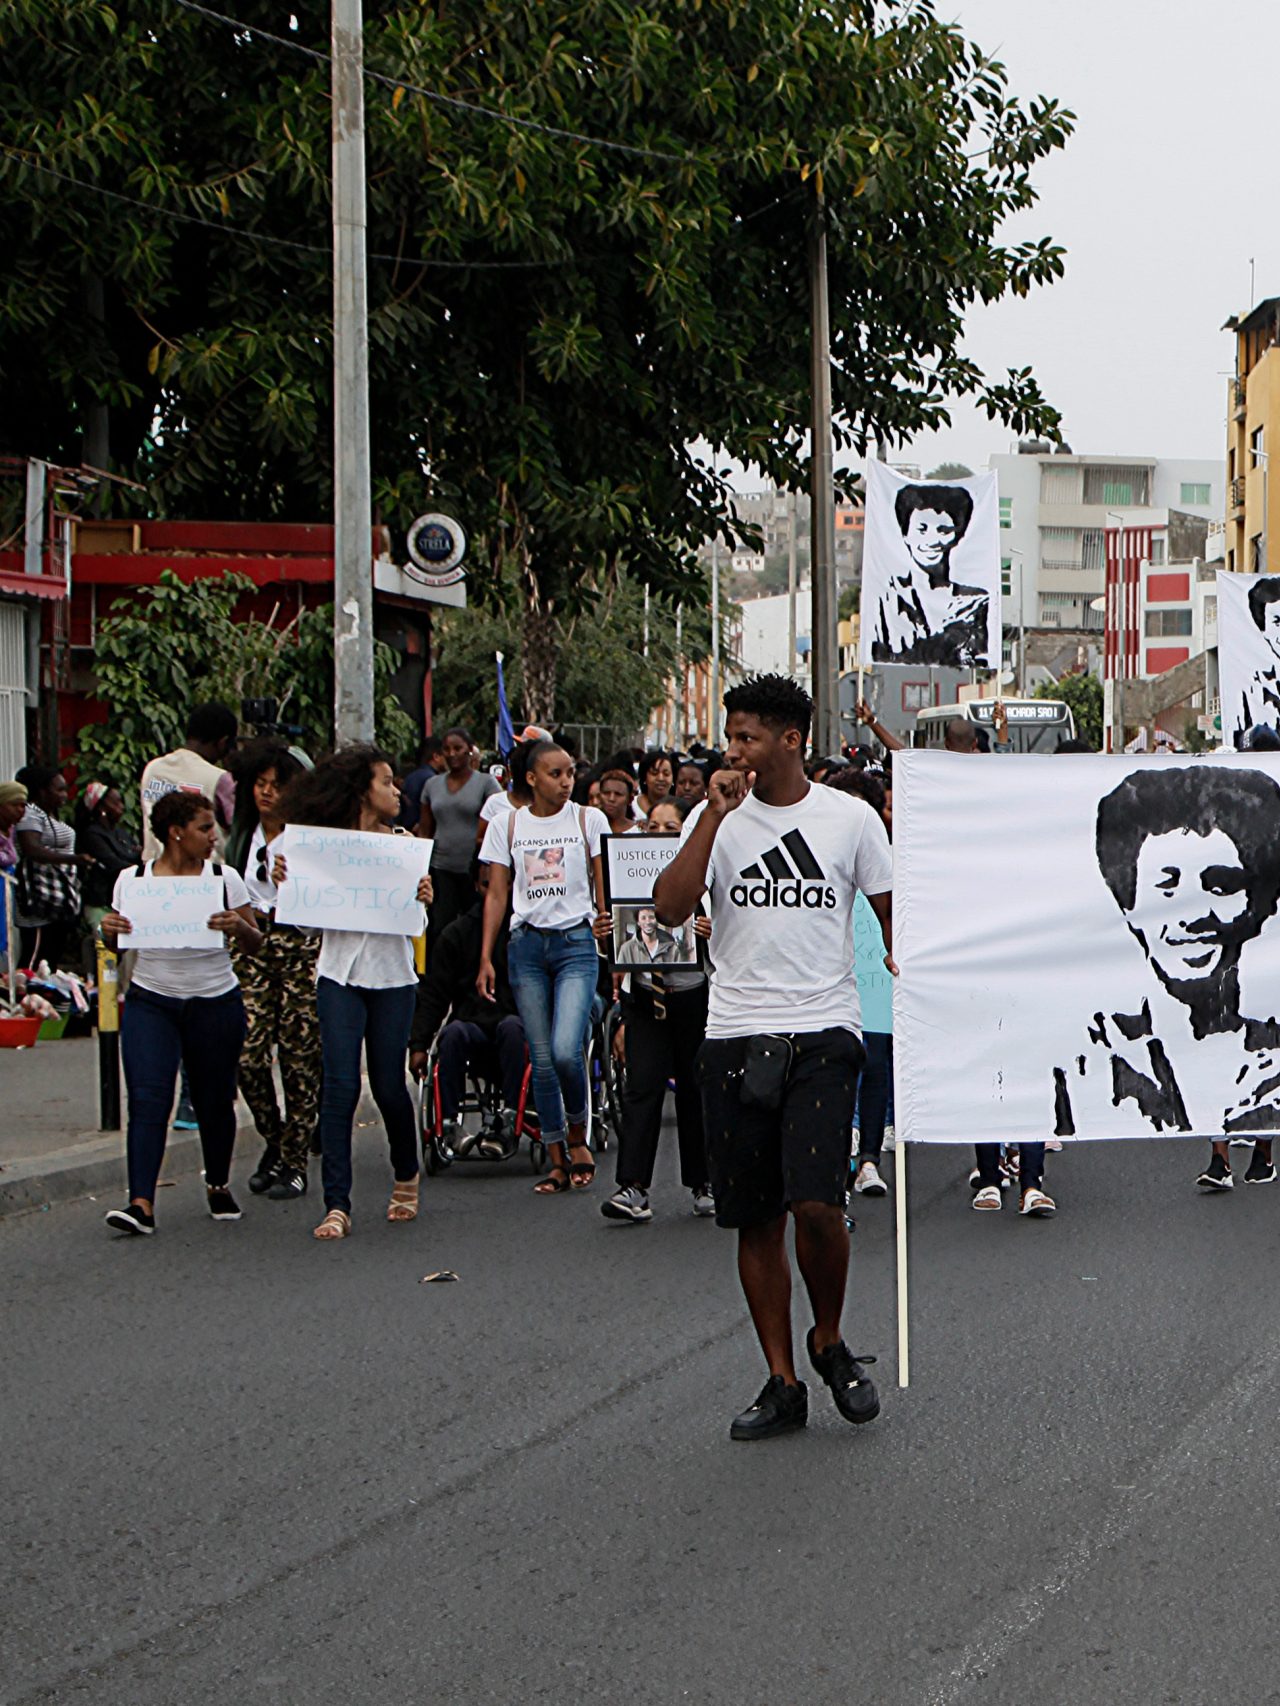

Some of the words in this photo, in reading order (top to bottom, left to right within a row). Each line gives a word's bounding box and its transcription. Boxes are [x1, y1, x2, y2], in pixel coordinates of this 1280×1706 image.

[418, 538, 451, 550] STRELA
[550, 837, 562, 845] EM
[564, 836, 579, 844] PAZ
[617, 850, 657, 861] JUSTICE
[627, 867, 664, 878] GIOVA
[526, 886, 567, 900] GIOVANI
[730, 879, 836, 909] adidas
